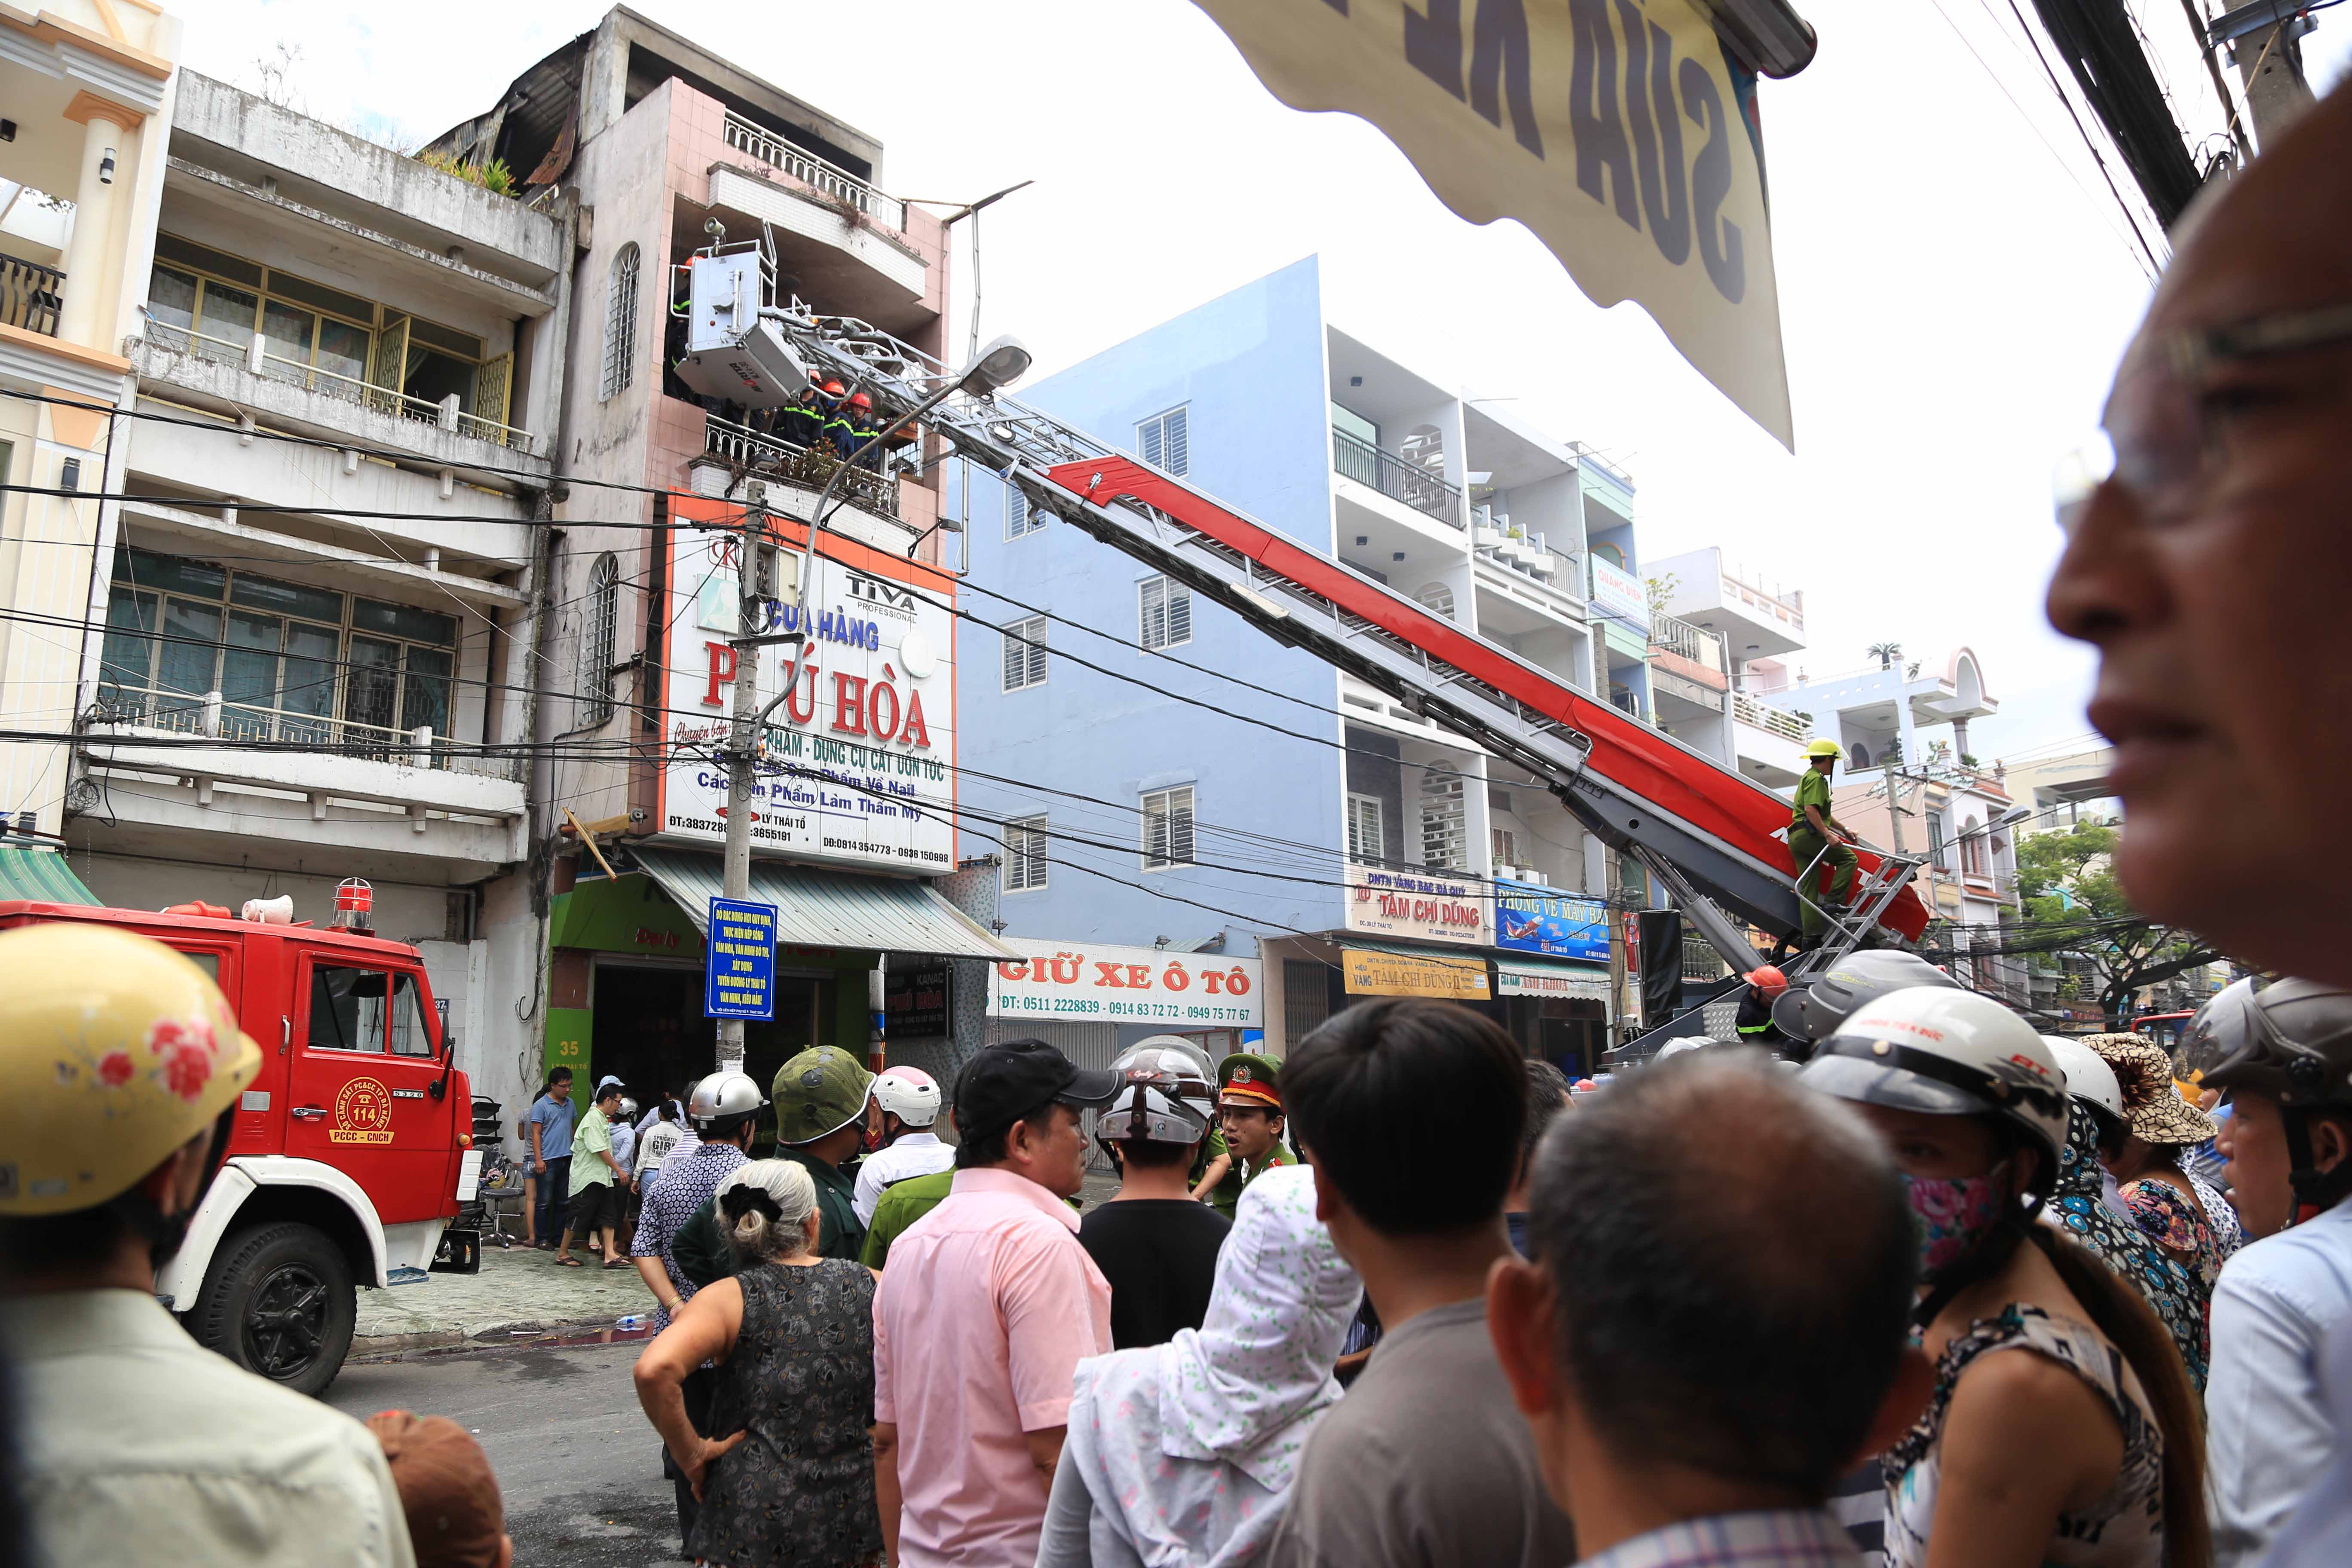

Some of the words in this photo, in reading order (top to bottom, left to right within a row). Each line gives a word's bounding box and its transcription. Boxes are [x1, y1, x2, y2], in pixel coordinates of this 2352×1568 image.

[1598, 569, 1624, 592] QUANG
[858, 602, 916, 624] PROFESSIONAL
[818, 606, 879, 651] HÀNG
[701, 640, 819, 724] PÚ
[830, 662, 931, 748] HÒA
[814, 738, 845, 767] DỤNG
[851, 745, 866, 773] CỤ
[871, 744, 891, 773] CẮT
[897, 749, 920, 778] UỐN
[923, 755, 944, 781] TÓC
[698, 772, 729, 790] Các
[772, 784, 815, 804] Phẩm
[821, 792, 851, 810] Làm
[858, 798, 897, 817] Thẩm
[902, 806, 922, 822] Mỹ
[888, 781, 915, 796] Nail
[763, 812, 771, 824] LÝ
[775, 814, 793, 828] THÁI
[796, 815, 806, 829] TỔ
[858, 842, 891, 855] 354773
[898, 847, 919, 859] 0936
[921, 851, 949, 863] 150998
[1368, 873, 1392, 886] DNTN
[1378, 891, 1410, 919] TÂM
[1415, 897, 1438, 922] CHÍ
[1442, 900, 1479, 927] DŨNG
[1498, 888, 1540, 914] PHÒNG
[1562, 899, 1586, 922] MÁY
[723, 908, 731, 921] RÁC
[732, 910, 743, 922] ĐÚNG
[752, 913, 760, 924] QUY
[1568, 929, 1586, 940] Jetstar
[744, 945, 755, 956] MINH
[746, 975, 750, 988] LÝ
[751, 977, 760, 989] THÁI
[998, 952, 1085, 984] GIỮ
[1094, 961, 1152, 989] XE
[1163, 960, 1190, 992] Ô
[1200, 965, 1251, 996] TÔ
[1354, 972, 1372, 987] VÀNG
[1372, 968, 1398, 986] TÂM
[1402, 968, 1421, 987] CHÍ
[435, 1000, 445, 1009] 37
[1002, 997, 1020, 1010] ĐT:
[1023, 997, 1050, 1011] 0511
[1054, 998, 1099, 1014] 2228839
[1109, 1001, 1134, 1015] 0914
[1137, 1003, 1149, 1016] 83
[1152, 1004, 1164, 1017] 72
[1167, 1005, 1179, 1017] 72
[1187, 1006, 1211, 1019] 0949
[1213, 1007, 1225, 1019] 75
[1226, 1008, 1237, 1020] 77
[1239, 1009, 1250, 1021] 67
[560, 1041, 578, 1056] 35
[343, 1086, 353, 1099] SÁT
[354, 1082, 376, 1090] PC&CC
[353, 1107, 376, 1121] 114
[334, 1132, 357, 1141] PCCC
[367, 1133, 389, 1142] CNCH
